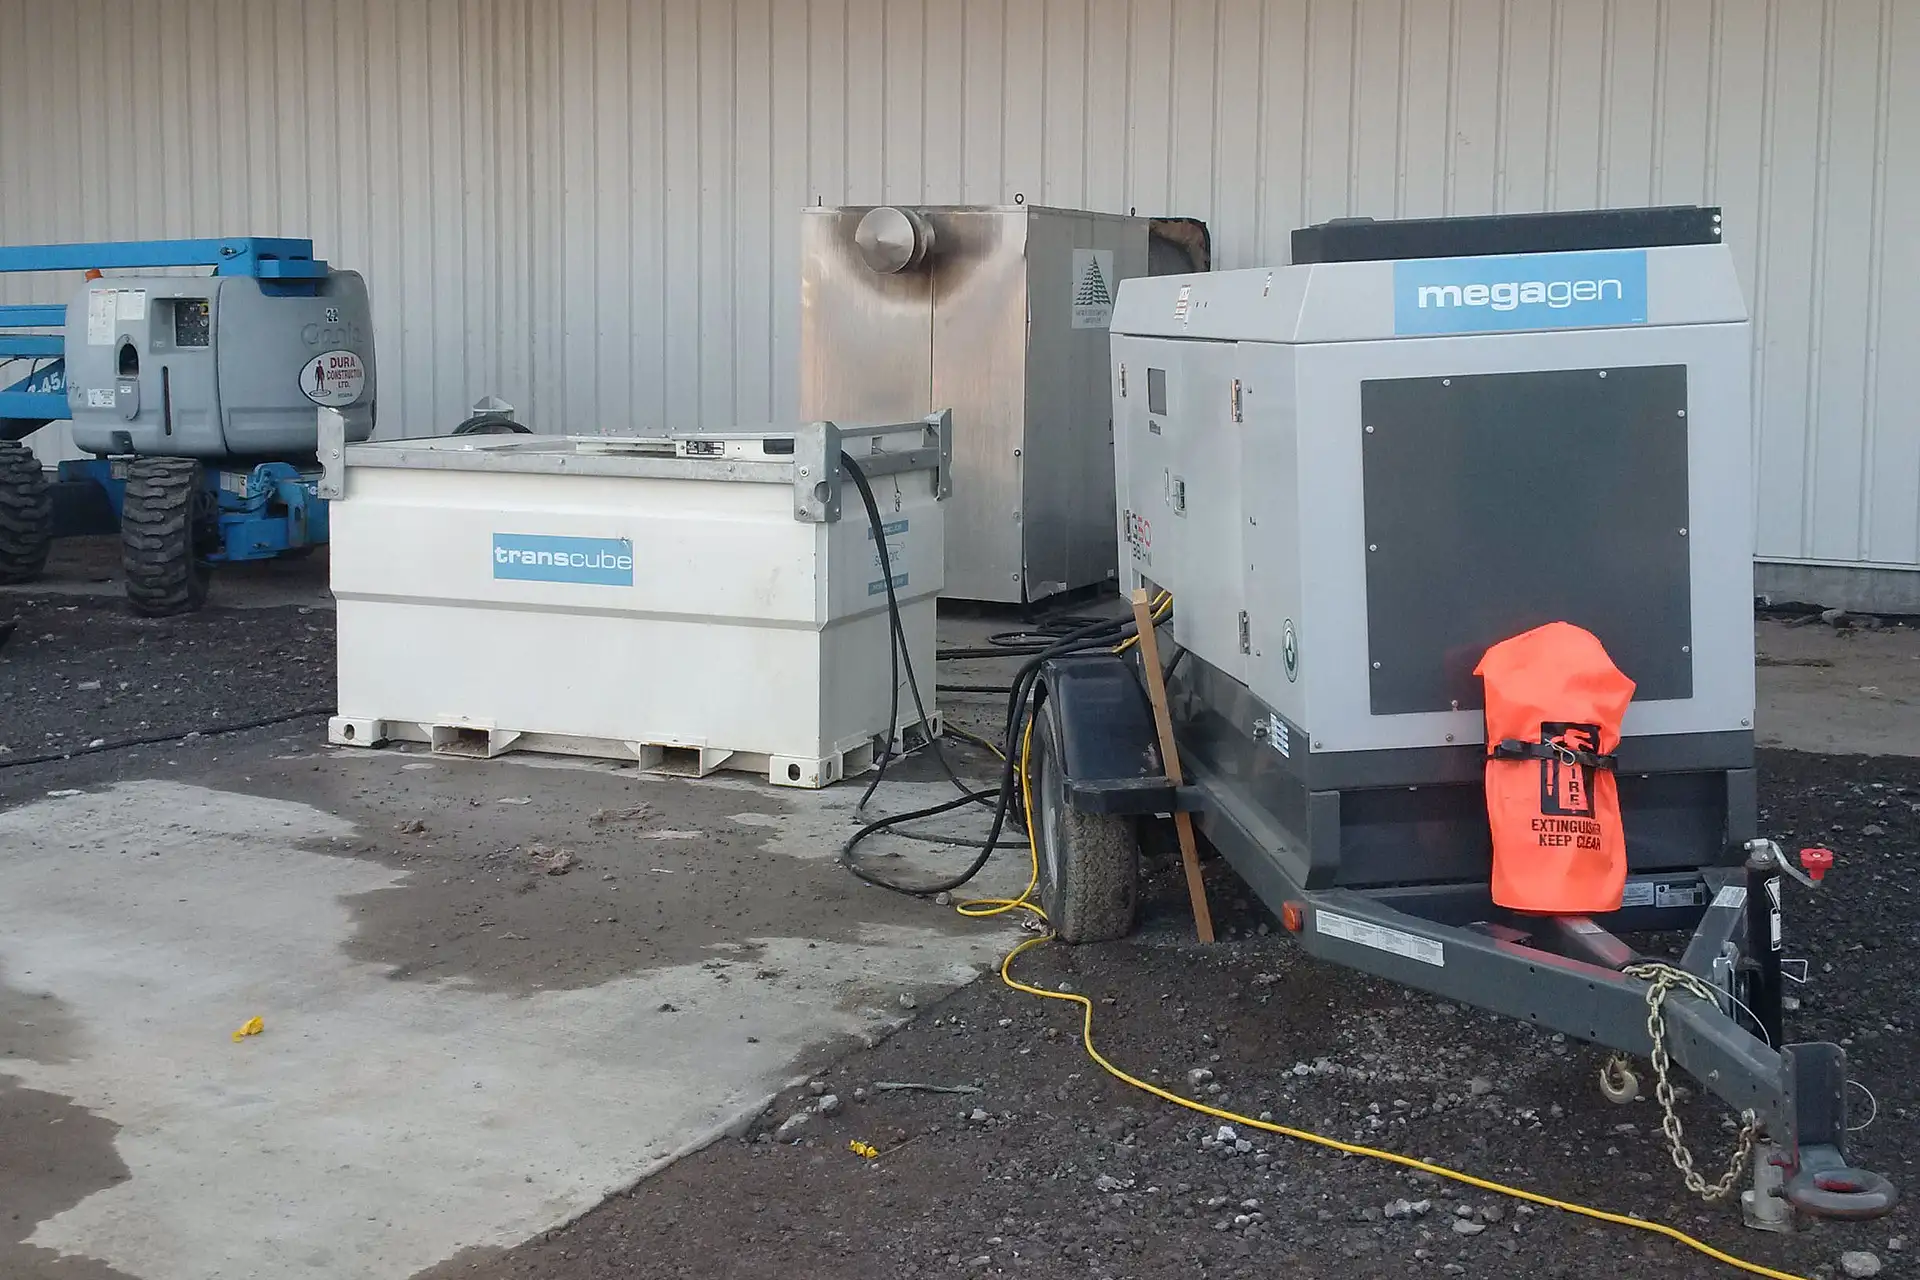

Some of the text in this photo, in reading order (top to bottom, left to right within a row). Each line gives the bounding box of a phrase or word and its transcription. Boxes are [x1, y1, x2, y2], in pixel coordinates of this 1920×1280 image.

[1418, 279, 1622, 310] megagen
[330, 357, 355, 369] DURA
[494, 546, 632, 570] transcube
[1539, 834, 1572, 846] KEEP
